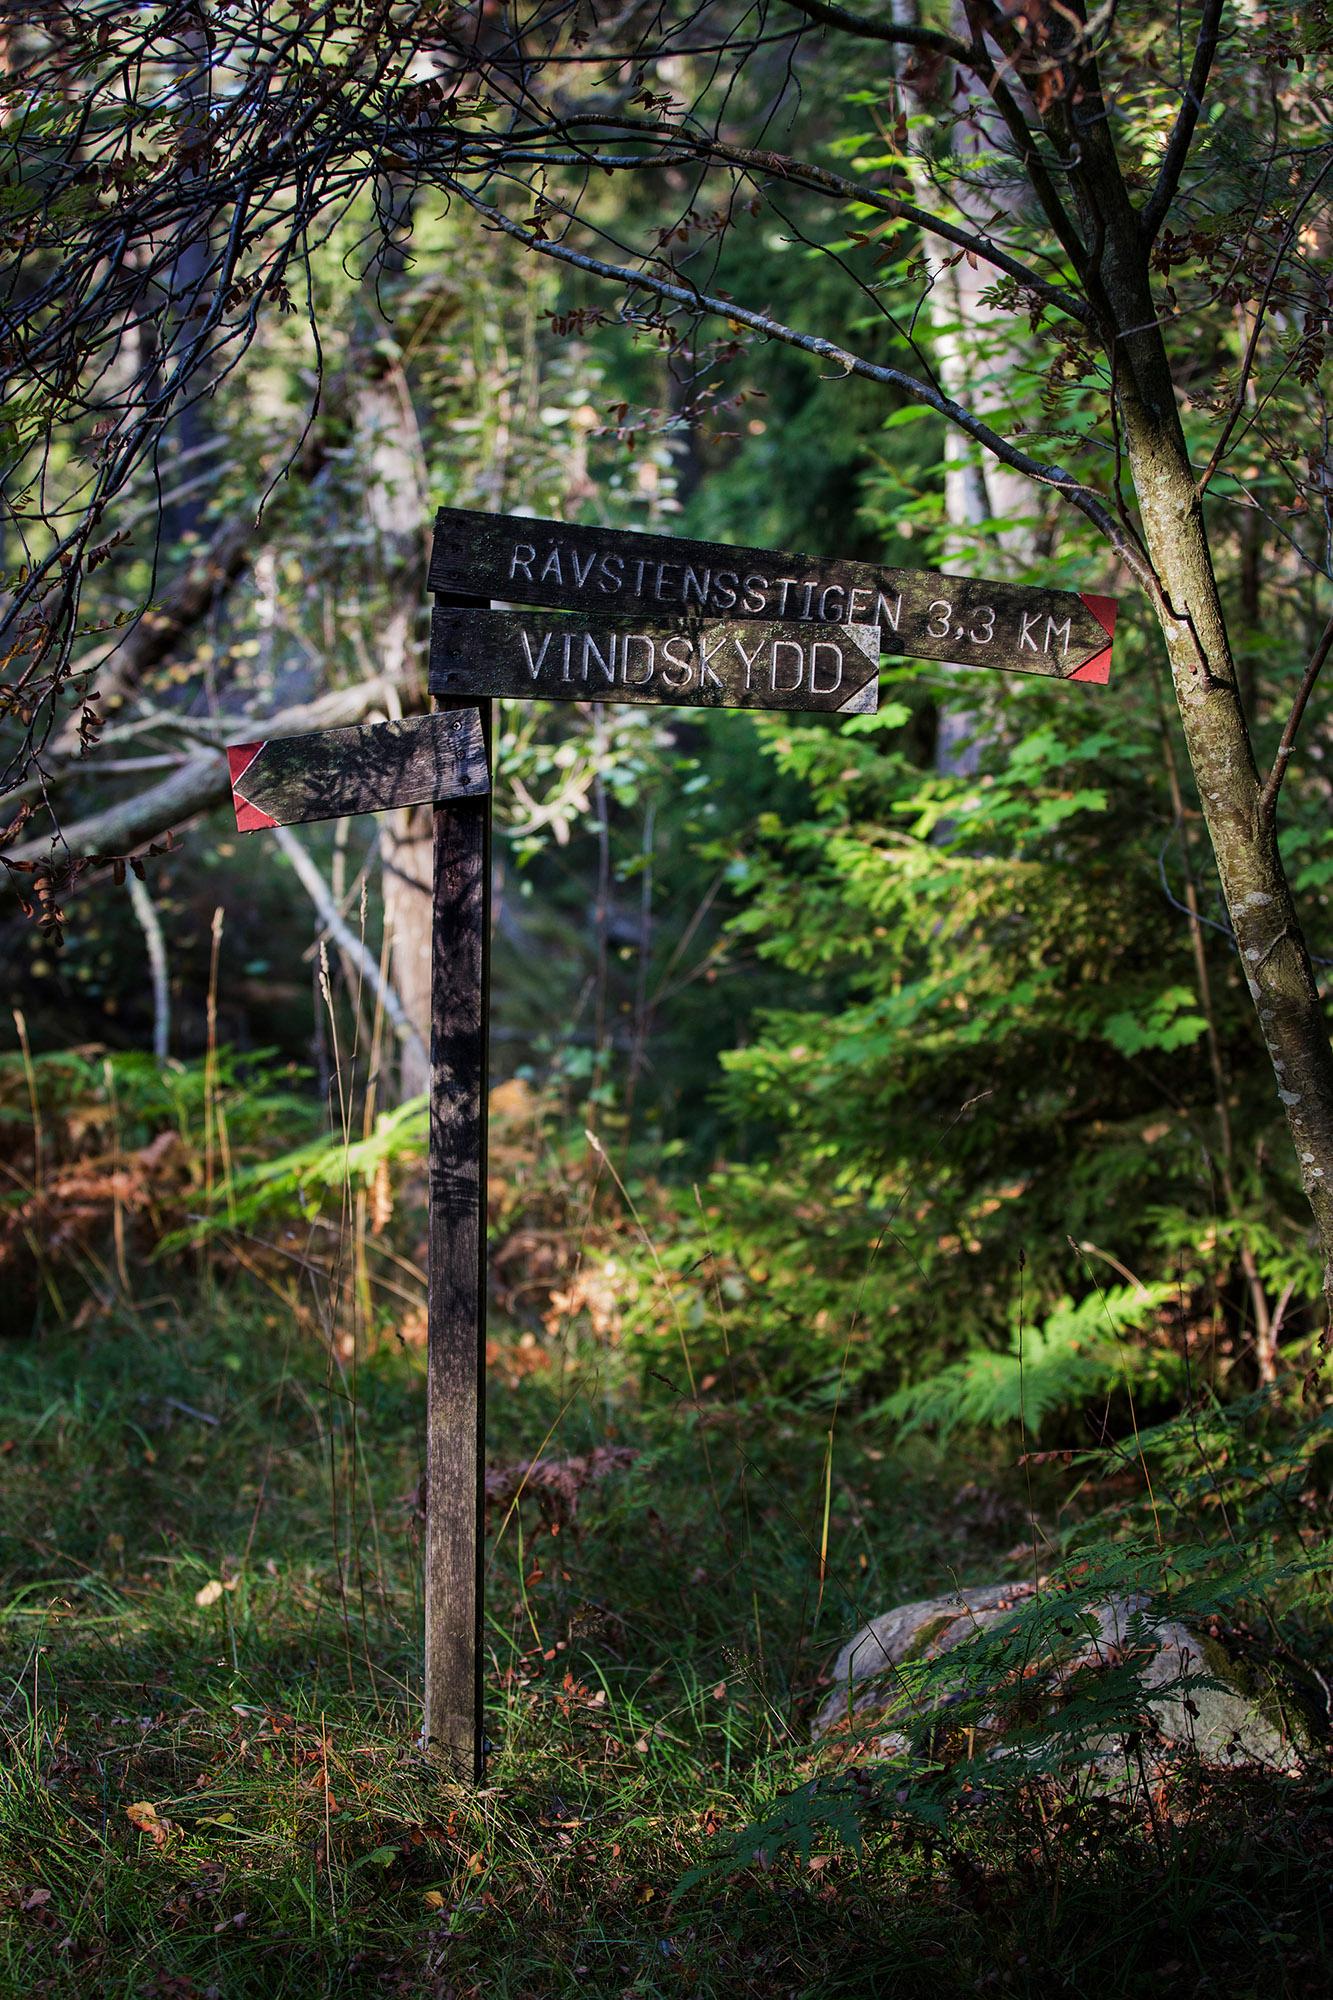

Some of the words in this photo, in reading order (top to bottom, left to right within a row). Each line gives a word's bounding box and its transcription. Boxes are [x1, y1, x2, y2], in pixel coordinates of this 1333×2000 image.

[508, 537, 902, 632] RÄVSTENSSTIGEN
[926, 599, 997, 645] 3,3
[1019, 610, 1072, 656] KM
[520, 630, 844, 695] VINDSKYDD
